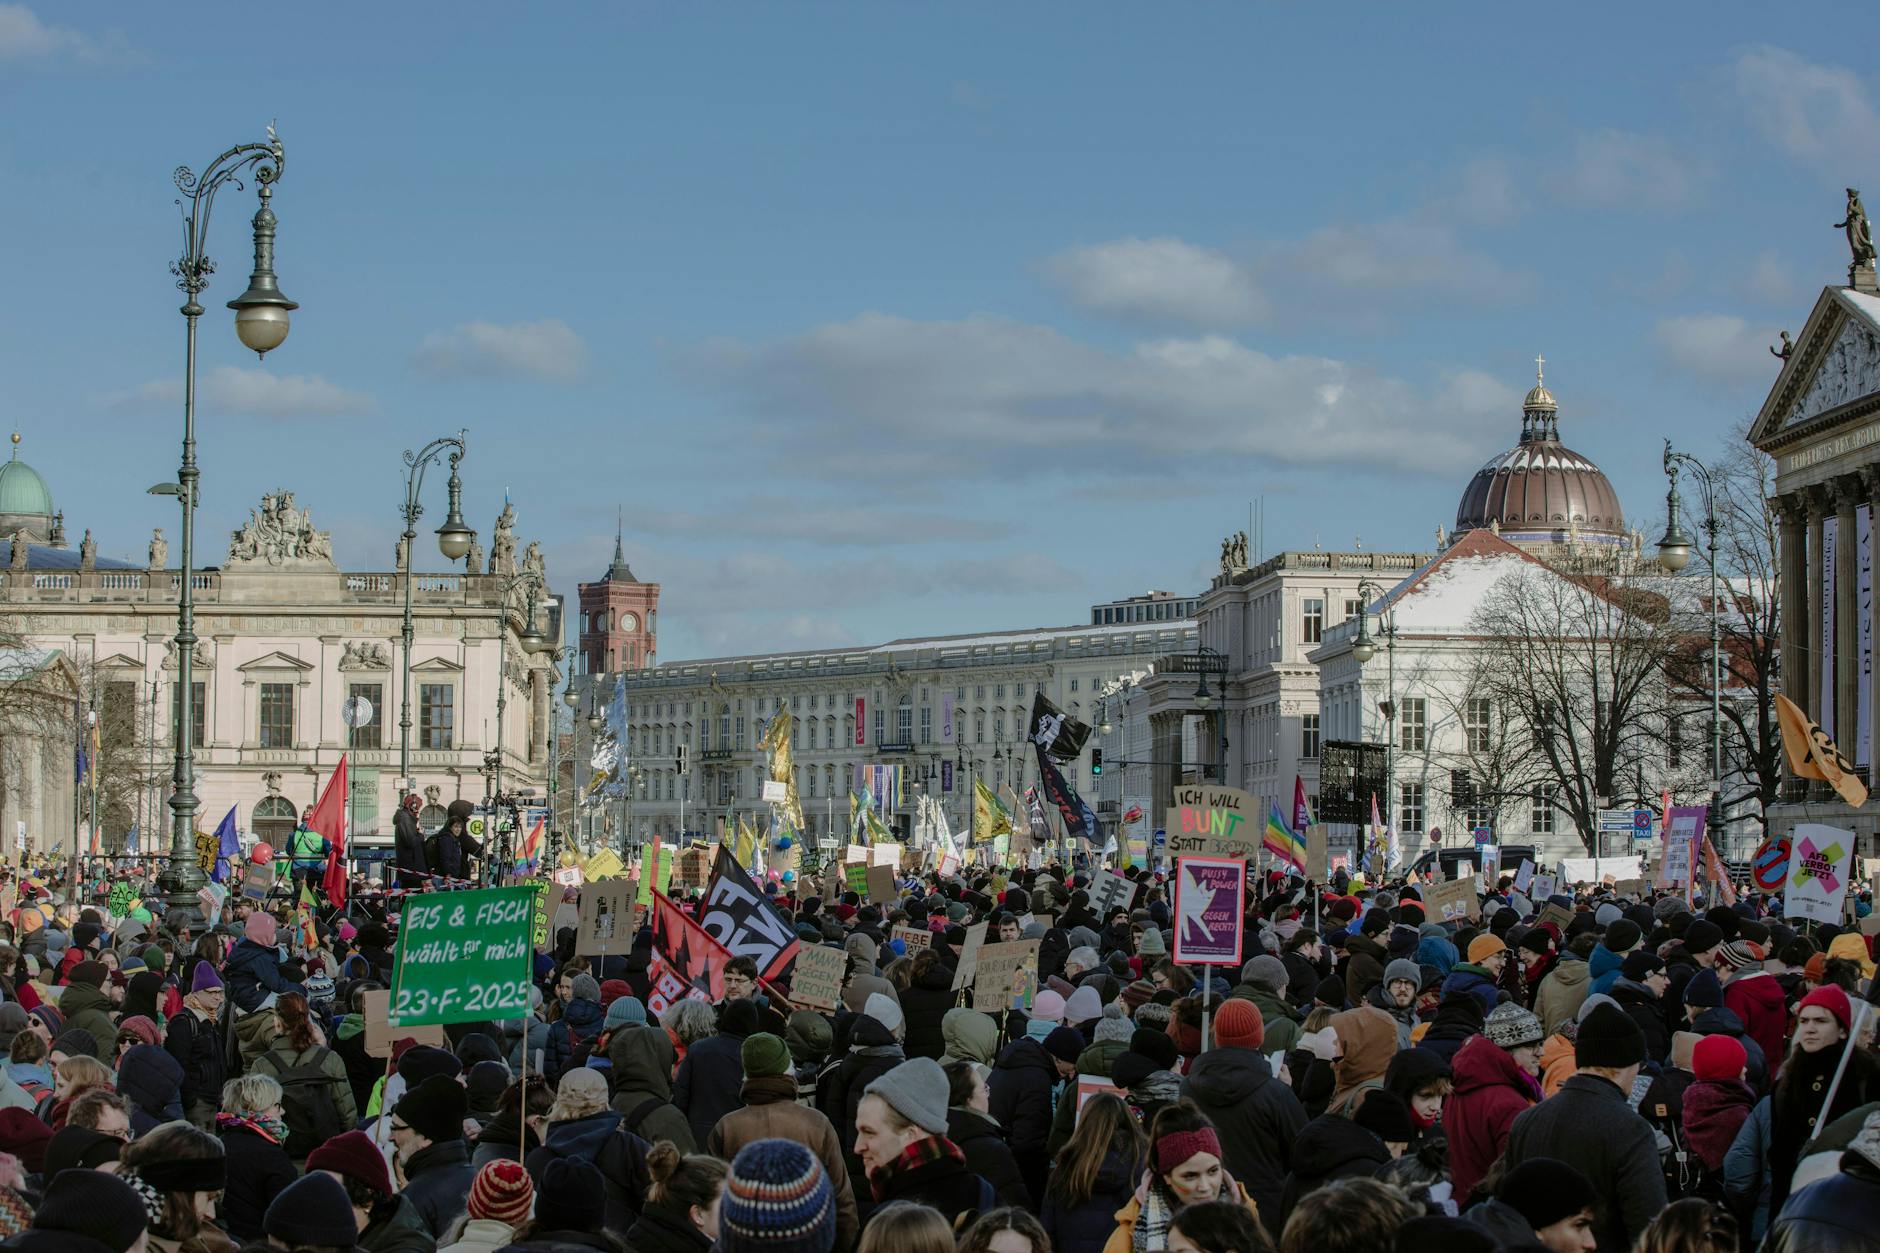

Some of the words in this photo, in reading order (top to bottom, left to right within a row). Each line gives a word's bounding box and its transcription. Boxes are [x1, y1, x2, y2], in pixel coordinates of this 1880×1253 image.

[1180, 790, 1203, 805] ICH
[1210, 793, 1240, 809] WILL
[1181, 807, 1245, 837] BUNT
[1636, 829, 1651, 837] TAXI
[1169, 835, 1206, 851] STATT
[1808, 851, 1829, 862] AFD
[1800, 860, 1837, 873] VERBOT
[1801, 868, 1833, 881] JETZT
[407, 904, 443, 930] EIS
[448, 905, 466, 927] &
[475, 899, 530, 926] FISCH
[1203, 911, 1230, 921] GEGEN
[402, 940, 458, 964] wählt
[463, 939, 481, 956] für
[484, 935, 526, 961] mich
[806, 949, 842, 969] MAMA
[798, 966, 836, 982] GEGEN
[796, 978, 837, 999] RECHTS
